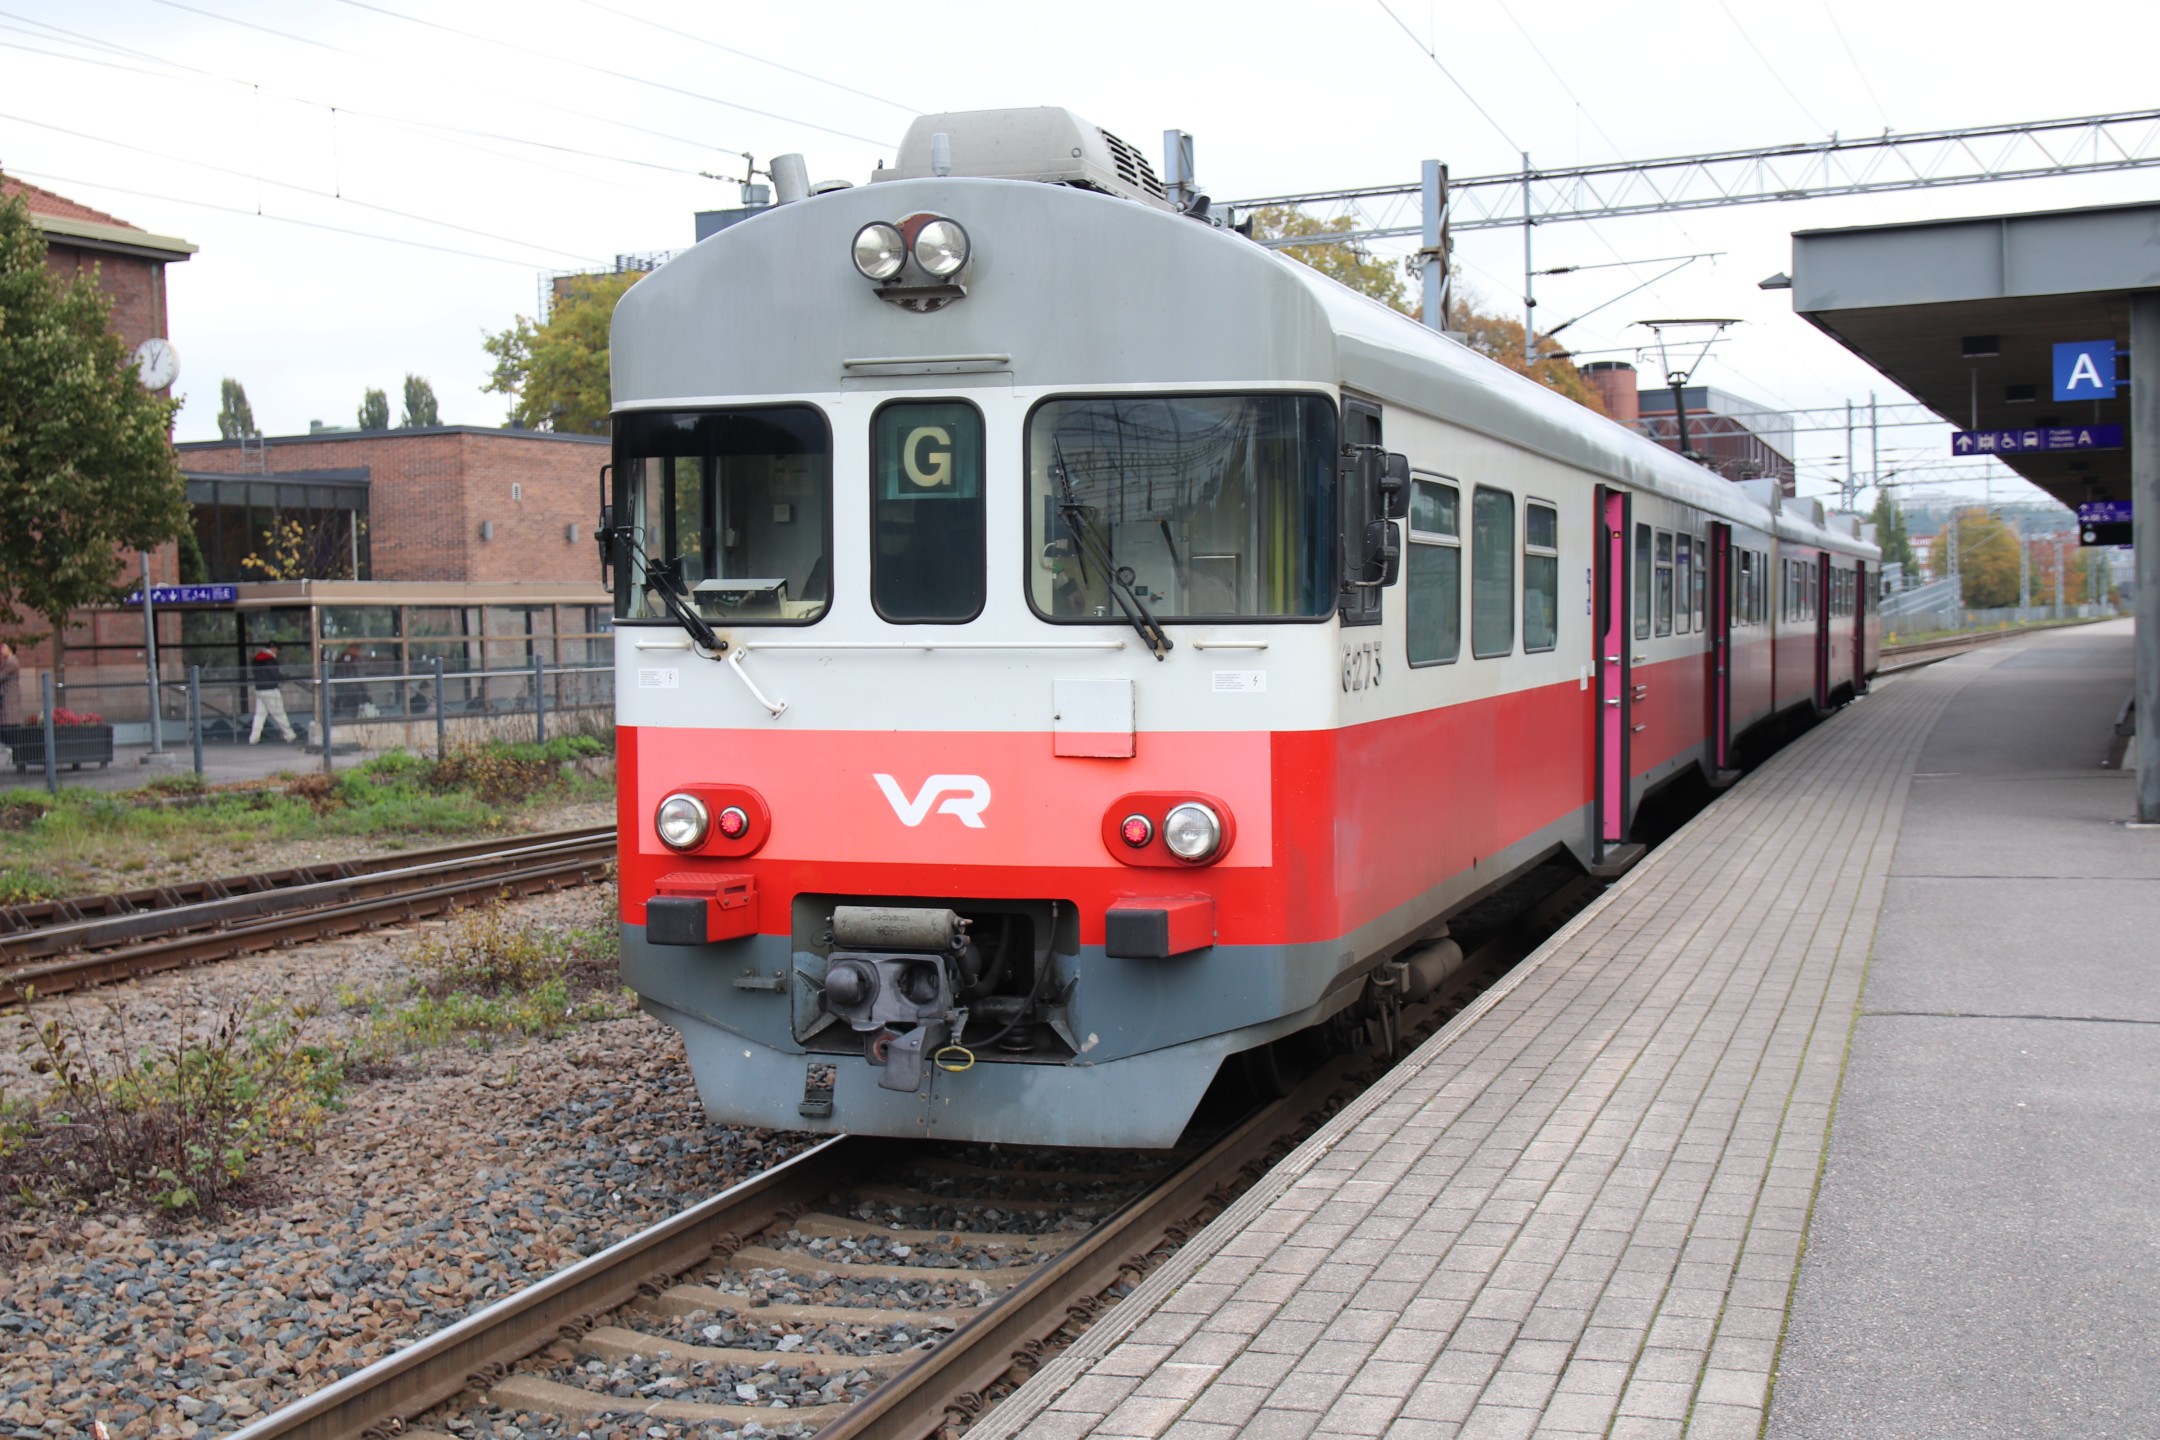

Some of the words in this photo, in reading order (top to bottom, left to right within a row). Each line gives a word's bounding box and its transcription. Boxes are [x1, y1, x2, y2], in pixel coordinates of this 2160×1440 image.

[2066, 353, 2103, 390] A
[903, 426, 952, 487] G
[2077, 429, 2093, 445] A
[872, 773, 991, 828] VR
